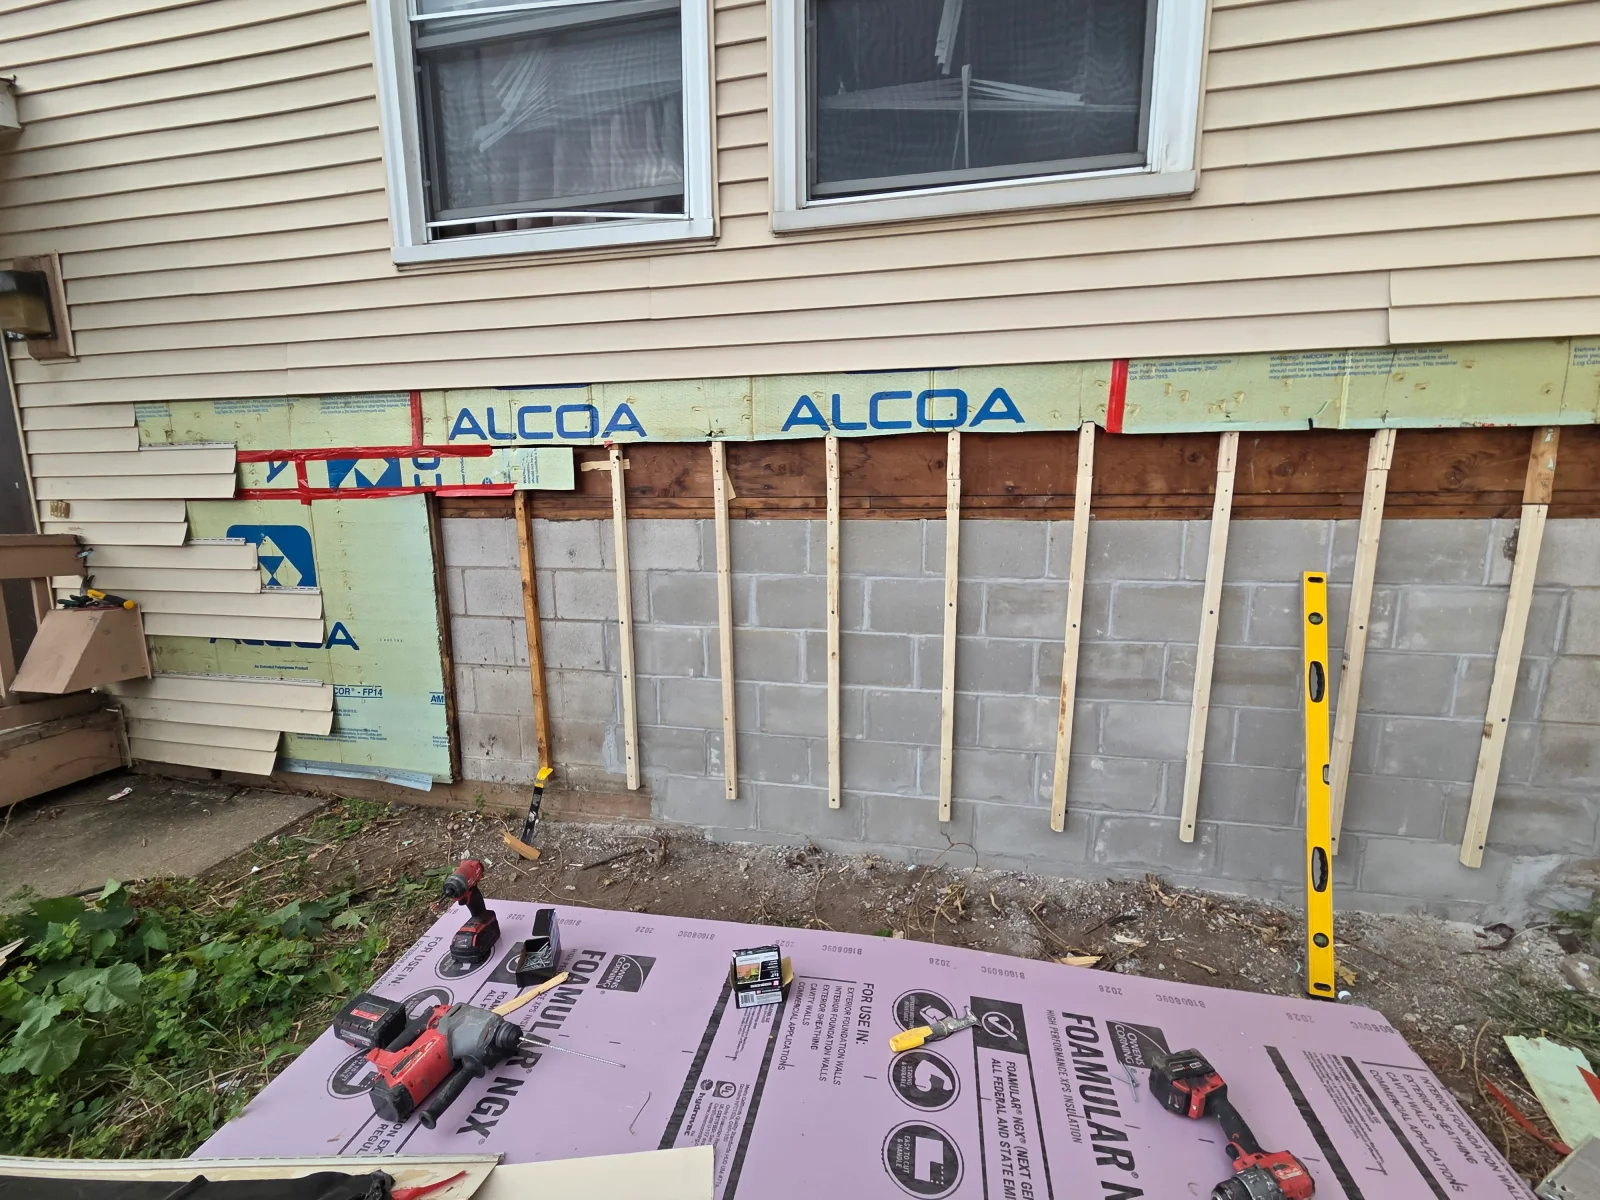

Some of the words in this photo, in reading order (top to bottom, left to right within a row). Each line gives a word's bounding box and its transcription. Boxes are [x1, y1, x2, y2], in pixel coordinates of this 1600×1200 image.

[448, 402, 648, 440] ALCOA
[780, 387, 1026, 432] ALCOA
[362, 688, 383, 697] FP14
[634, 925, 655, 934] 2026
[421, 936, 444, 953] FOR
[402, 955, 426, 973] USE
[602, 957, 626, 988] CORNING
[928, 957, 951, 968] 2026
[388, 974, 407, 987] IN:
[611, 963, 630, 989] OWENS
[483, 990, 496, 1001] ALL
[789, 982, 806, 1021] COMMERCIAL
[807, 983, 818, 1005] CAVITY
[819, 984, 830, 1013] EXTERIOR
[831, 986, 842, 1013] INTERIOR
[844, 987, 854, 1016] EXTERIOR
[860, 982, 875, 1003] FOR
[1098, 984, 1123, 996] 2026
[529, 1000, 541, 1013] XPS
[802, 1005, 813, 1026] WALLS
[858, 1006, 872, 1027] USE
[1046, 1009, 1056, 1025] HIGH
[1285, 1012, 1316, 1024] 2026
[810, 1013, 825, 1051] SHEATHING
[824, 1013, 838, 1055] FOUNDATION
[837, 1016, 850, 1059] FOUNDATION
[855, 1029, 869, 1045] IN:
[1114, 1024, 1134, 1064] CORNING
[777, 1021, 796, 1071] APPLICATIONS
[1050, 1026, 1068, 1077] PERFORMANCE
[1127, 1032, 1144, 1066] OWENS
[819, 1057, 831, 1082] WALLS
[833, 1060, 844, 1086] WALLS
[991, 1058, 1002, 1073] ALL
[721, 1085, 732, 1094] UL
[993, 1075, 1007, 1115] FEDERAL
[1060, 1077, 1072, 1093] XPS
[1386, 1071, 1412, 1102] CAVITY
[1408, 1101, 1435, 1130] WALLS
[684, 1092, 706, 1136] hydrovac
[1062, 1094, 1083, 1143] INSULATION
[1402, 1073, 1438, 1112] EXTERIOR
[1432, 1112, 1479, 1165] SHEATHING
[1419, 1075, 1454, 1113] INTERIOR
[1448, 1112, 1502, 1172] FOUNDATION
[997, 1117, 1009, 1139] AND
[1369, 1069, 1412, 1122] COMMERCIAL
[1408, 1122, 1464, 1193] APPLICATIONS
[903, 1135, 911, 1151] EASY
[999, 1140, 1014, 1177] STATE
[1013, 1145, 1032, 1180] (NEXT
